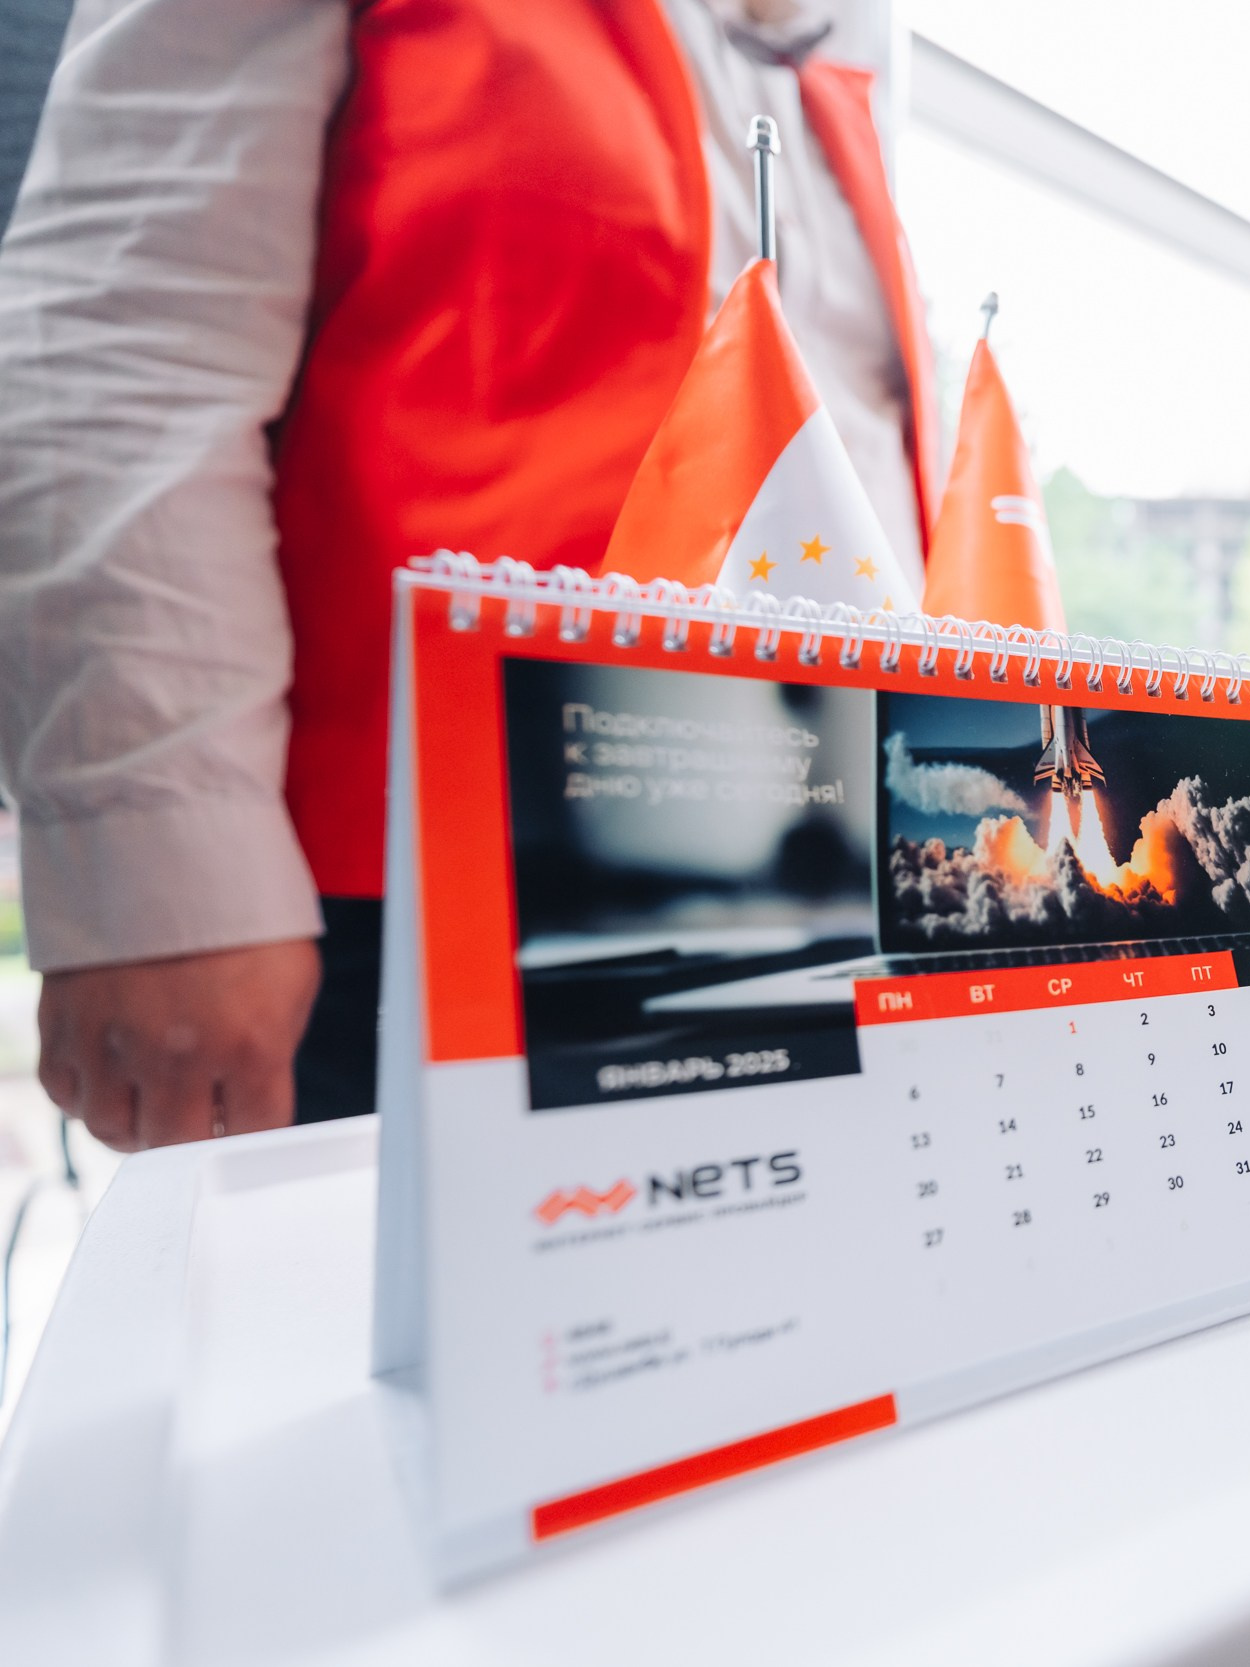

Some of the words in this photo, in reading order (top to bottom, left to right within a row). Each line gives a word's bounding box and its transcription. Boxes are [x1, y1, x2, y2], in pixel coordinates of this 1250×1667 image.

[877, 991, 913, 1011] ПН
[969, 984, 995, 1004] ВТ
[1047, 977, 1073, 996] СР
[1122, 971, 1144, 987] ЧТ
[1190, 965, 1213, 981] ПТ
[1068, 1021, 1077, 1035] 1
[1140, 1012, 1149, 1026] 2
[1207, 1004, 1216, 1017] 3
[724, 1048, 791, 1078] 2025
[909, 1087, 920, 1101] 6
[995, 1073, 1005, 1089] 7
[1075, 1062, 1085, 1077] 8
[1147, 1052, 1156, 1066] 9
[1211, 1042, 1227, 1056] 10
[999, 1118, 1017, 1134] 14
[1079, 1104, 1096, 1120] 15
[1152, 1092, 1168, 1107] 16
[1219, 1080, 1234, 1095] 17
[1005, 1164, 1024, 1181] 21
[1085, 1148, 1103, 1164] 22
[1159, 1133, 1176, 1149] 23
[1227, 1120, 1243, 1135] 24
[1013, 1209, 1032, 1227] 28
[1093, 1191, 1110, 1208] 29
[1167, 1175, 1184, 1191] 30
